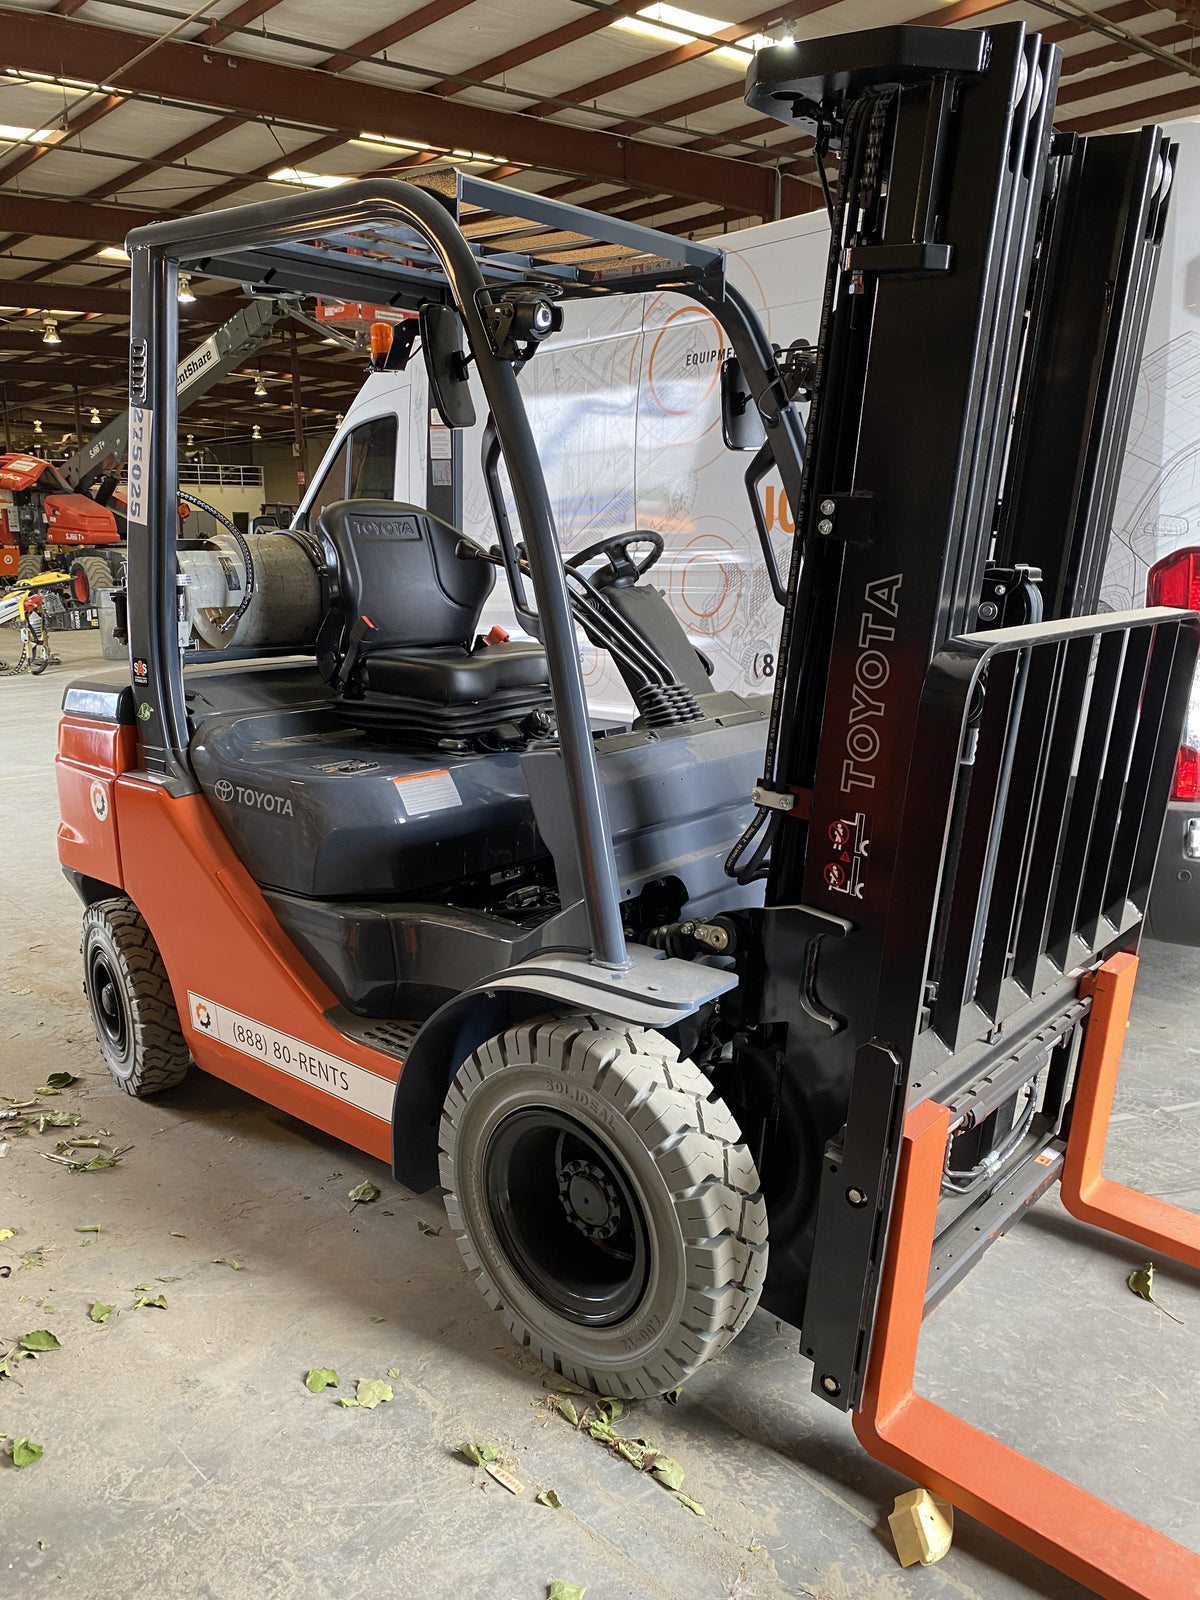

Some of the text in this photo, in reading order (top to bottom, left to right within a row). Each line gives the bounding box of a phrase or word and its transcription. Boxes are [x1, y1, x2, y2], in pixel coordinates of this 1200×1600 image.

[686, 347, 737, 366] EQUIPME
[130, 408, 144, 518] 275025
[353, 521, 415, 537] TOYOTA
[133, 660, 148, 676] SAS
[840, 573, 903, 793] TOYOTA
[236, 786, 294, 817] TOYOTA
[232, 1022, 349, 1091] (888) 80-RENTS
